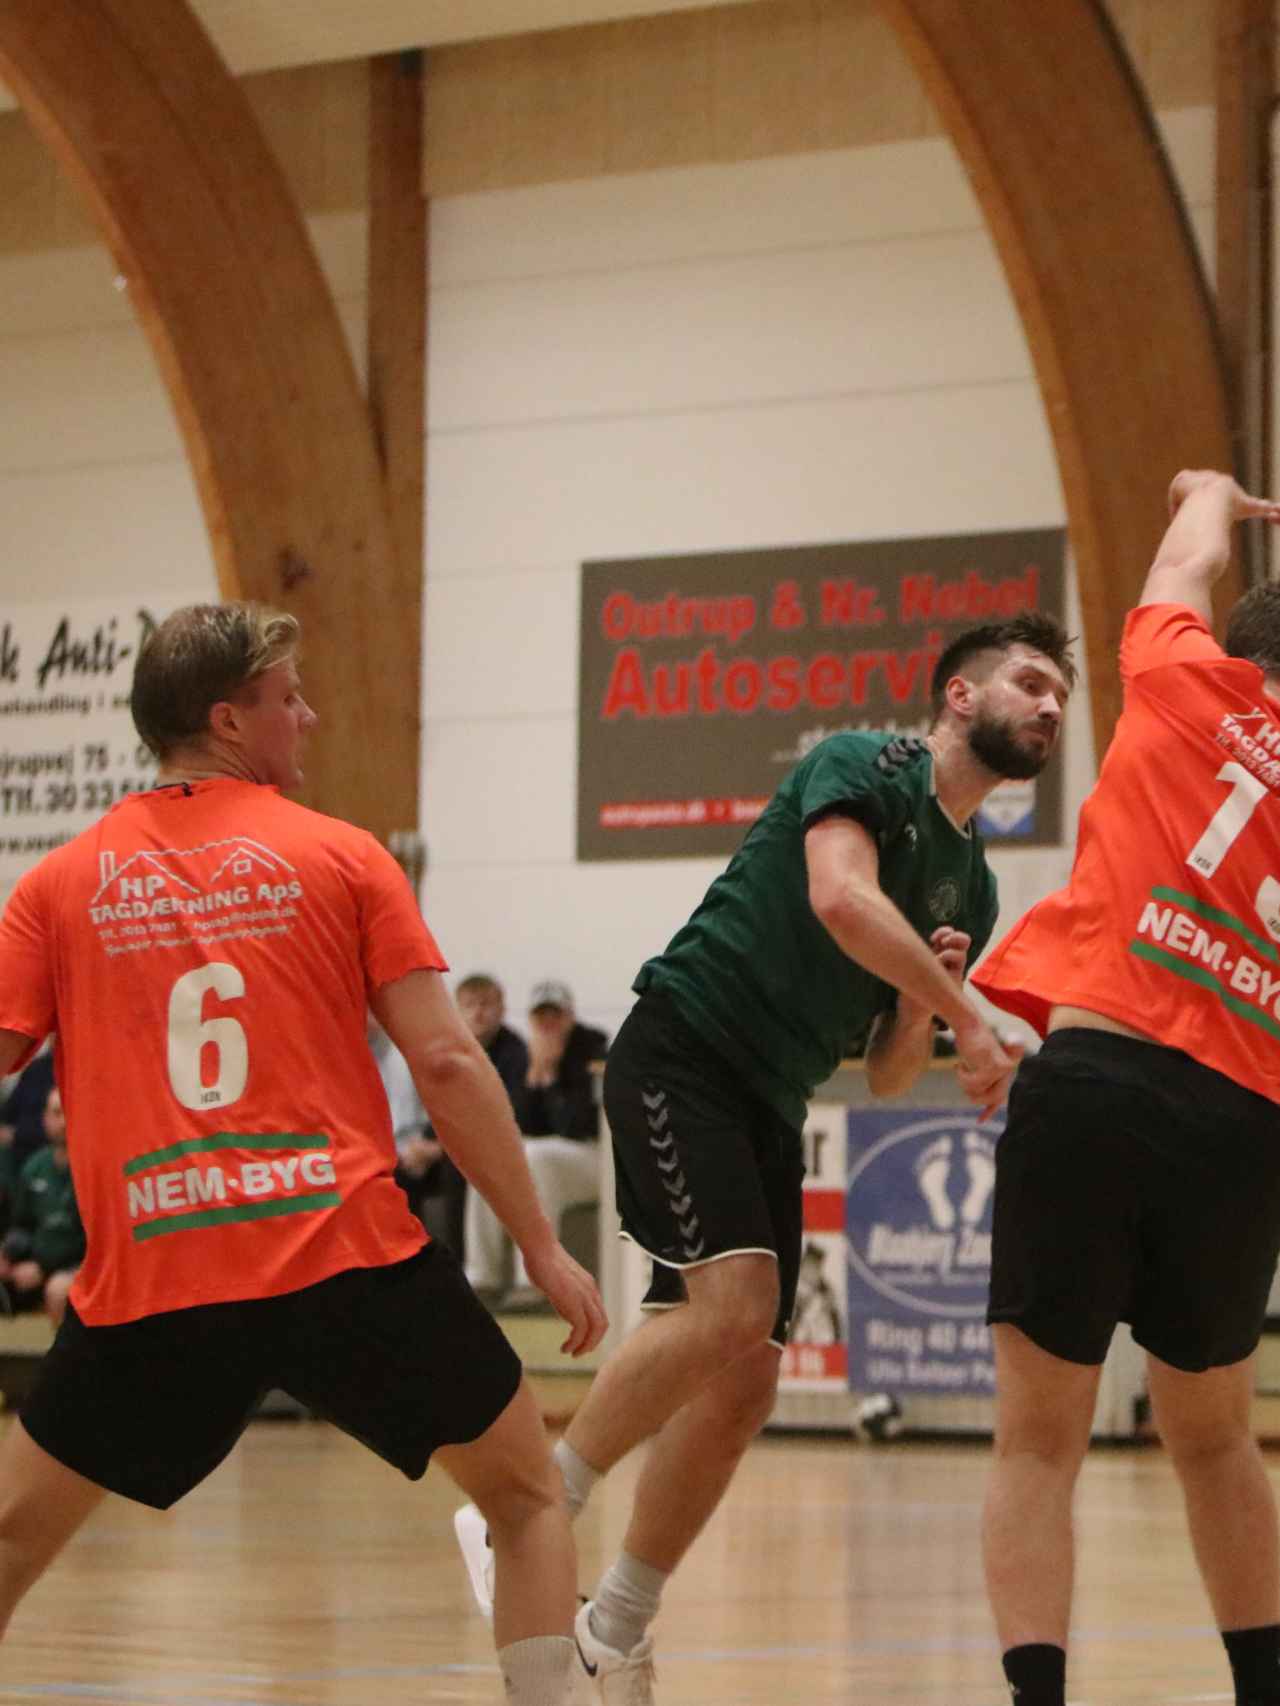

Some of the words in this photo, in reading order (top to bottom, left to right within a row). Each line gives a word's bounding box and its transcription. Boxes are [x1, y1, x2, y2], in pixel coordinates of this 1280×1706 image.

[603, 590, 757, 643] Outrup
[771, 578, 806, 631] &
[820, 577, 888, 625] Nr.
[903, 566, 1039, 620] Nebel
[600, 630, 943, 720] Autoservi
[88, 886, 250, 925] TAGDÆKNING
[256, 881, 304, 905] ApS
[119, 875, 165, 899] HP
[167, 961, 249, 1111] 6
